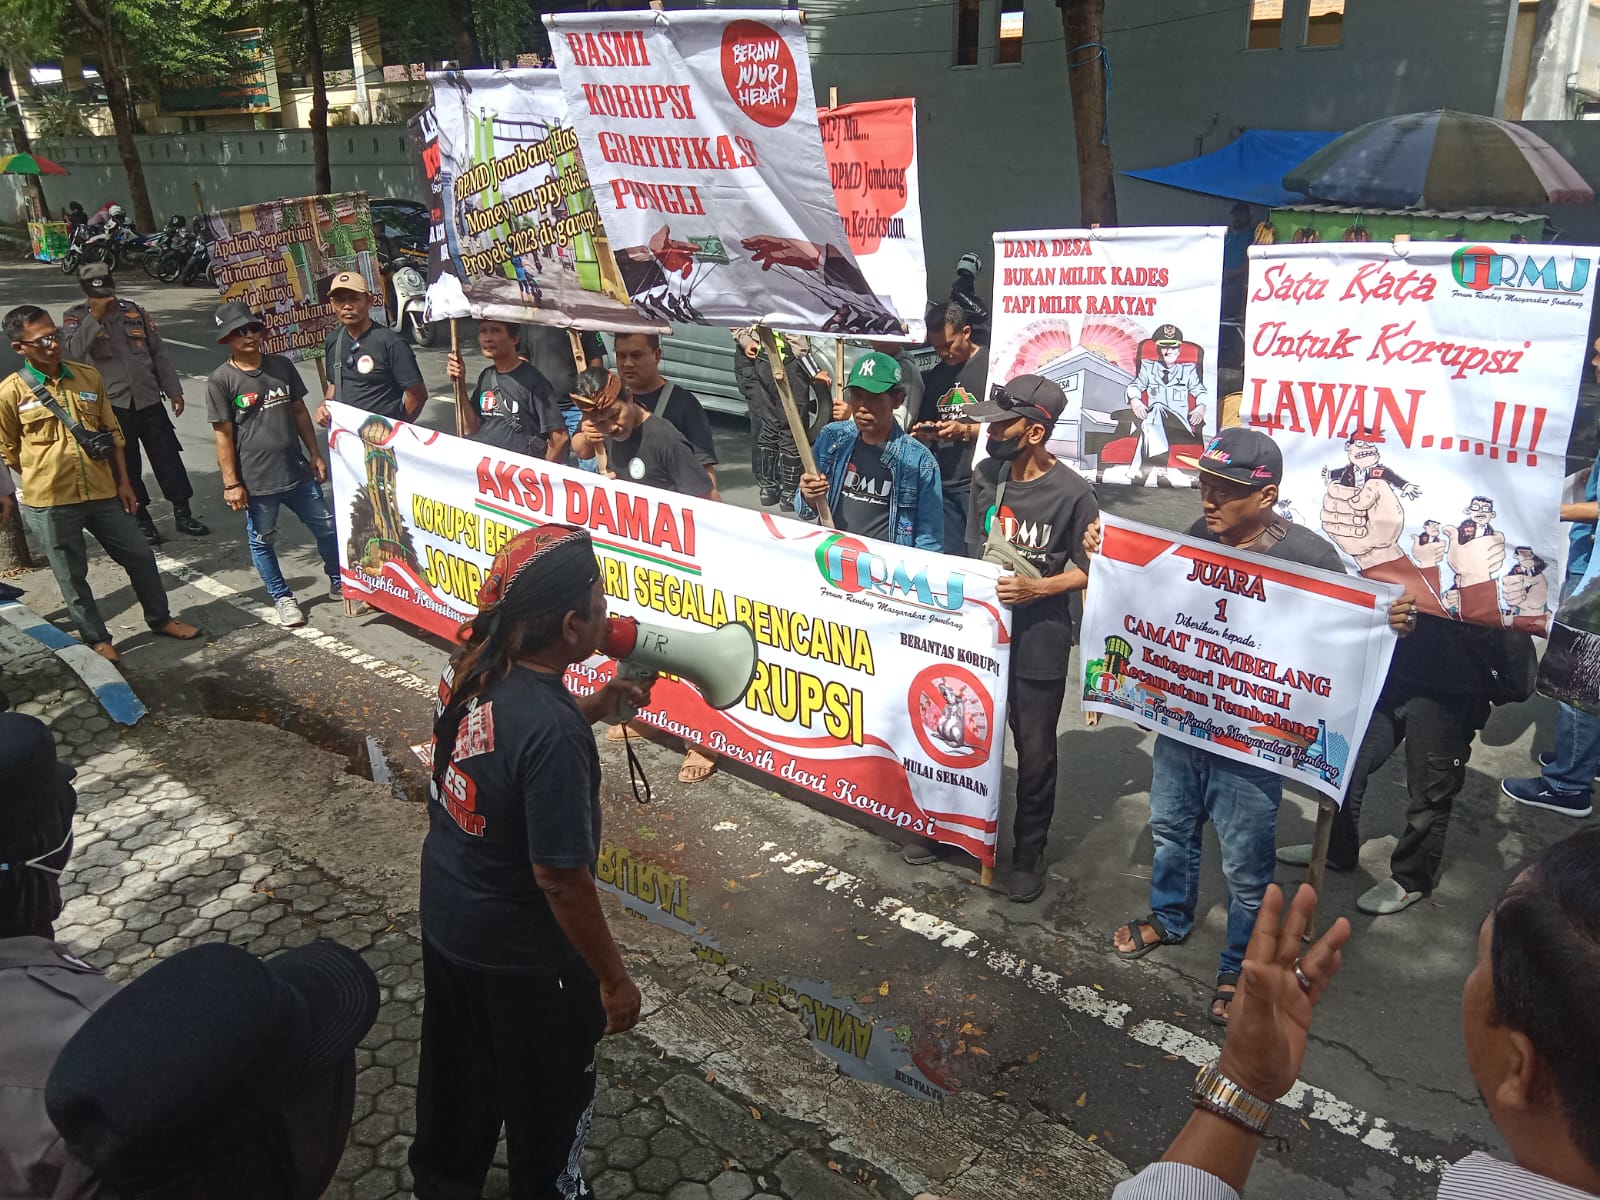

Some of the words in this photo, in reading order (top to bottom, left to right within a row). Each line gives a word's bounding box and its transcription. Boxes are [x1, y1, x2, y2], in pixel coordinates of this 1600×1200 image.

[566, 30, 651, 67] BASMI
[732, 39, 780, 65] BERANI
[581, 83, 696, 120] KORUPSI
[455, 164, 490, 201] DPMD
[490, 137, 556, 190] Jombang
[598, 131, 765, 170] GRATIFIKAS
[608, 178, 706, 216] PUNGLI
[831, 162, 862, 191] DPMD
[862, 160, 906, 199] Jombang
[465, 200, 510, 236] Monev
[511, 193, 537, 218] mu
[536, 179, 569, 213] piye
[214, 234, 258, 261] Apakah
[259, 225, 296, 251] seperti
[298, 223, 311, 242] ini
[460, 240, 509, 277] Proyek
[507, 228, 539, 257] 2023
[538, 219, 557, 245] di
[556, 211, 595, 247] garap
[851, 209, 906, 246] Kejaksaan
[1003, 239, 1048, 258] DANA
[1052, 238, 1093, 257] DESA
[221, 264, 234, 284] di
[234, 256, 288, 281] namakan
[1003, 267, 1056, 286] BUKAN
[1058, 266, 1107, 286] MILIK
[1111, 267, 1169, 287] KADES
[1251, 262, 1327, 306] Satu
[1340, 258, 1438, 306] Kata
[261, 284, 294, 304] karya
[1002, 296, 1036, 314] TAPI
[1038, 295, 1082, 314] MILIK
[1086, 296, 1157, 316] RAKYAT
[1451, 289, 1473, 298] Forum
[1475, 291, 1501, 302] Rembug
[1504, 293, 1550, 305] Masyarakat
[1551, 297, 1584, 309] Jombang
[263, 311, 291, 329] Desa
[291, 304, 323, 322] bukan
[262, 334, 289, 355] Milik
[291, 329, 326, 349] Rakyat
[1252, 321, 1362, 362] Untuk
[1366, 320, 1532, 380] Korupsi
[474, 456, 554, 517] AKSI
[562, 478, 696, 557] DAMAI
[355, 565, 410, 600] Teguhkan
[412, 587, 468, 624] Komitme
[412, 492, 481, 552] KORUPSI
[634, 565, 729, 630] SEGALA
[734, 595, 875, 676] BENCANA
[1187, 558, 1266, 602] JUARA
[820, 587, 843, 600] Forum
[845, 593, 875, 609] Rembug
[877, 601, 927, 621] Masyarakat
[929, 614, 964, 631] Jombang
[1214, 598, 1228, 623] 1
[899, 632, 955, 660] BERANTAS
[1175, 612, 1220, 637] Diberikan
[1222, 628, 1256, 648] kepada
[1123, 614, 1191, 653] CAMAT
[1194, 637, 1332, 698] TEMBELANG
[1142, 646, 1214, 687] Kategori
[1217, 673, 1292, 710] PUNGLI
[1119, 658, 1209, 708] Kecamatan
[1212, 693, 1319, 742] Tembelang
[1152, 698, 1183, 722] Forum
[1184, 710, 1224, 736] Rembug
[1227, 724, 1291, 757] Masyarakat
[1292, 748, 1340, 778] Jombang
[709, 731, 776, 773] Bersih
[780, 758, 827, 792] dari
[832, 778, 937, 836] Korupsi
[902, 757, 934, 779] MULAI
[936, 769, 989, 797] SEKARAN
